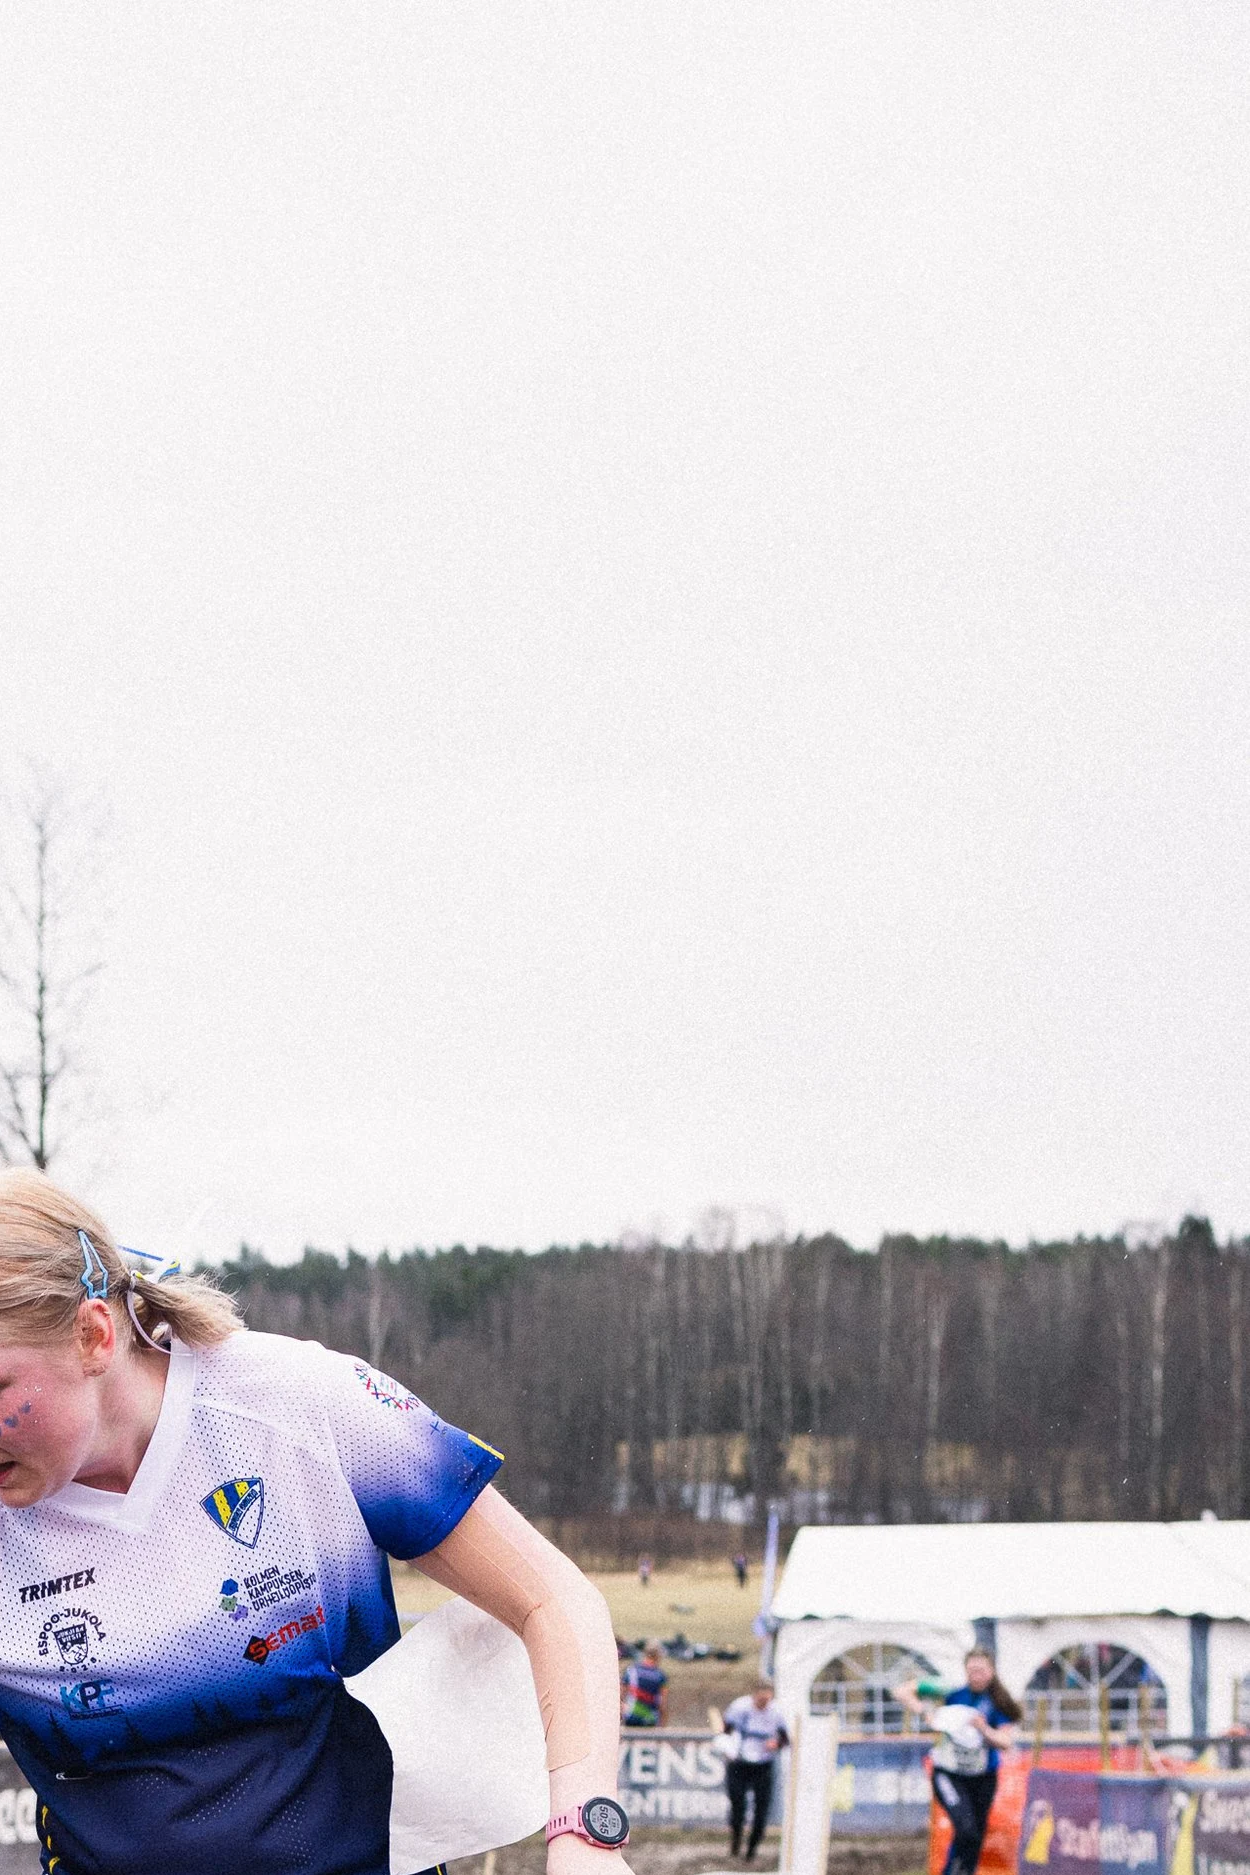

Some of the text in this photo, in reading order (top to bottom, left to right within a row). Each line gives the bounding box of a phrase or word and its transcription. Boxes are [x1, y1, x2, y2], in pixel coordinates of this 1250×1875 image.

[19, 1567, 95, 1603] TRIMTEX
[243, 1565, 280, 1589] KOLMEN
[248, 1569, 303, 1600] KAMPUKSEN
[38, 1608, 106, 1656] ESPOO-JUKOLA
[600, 1806, 609, 1835] 50:45
